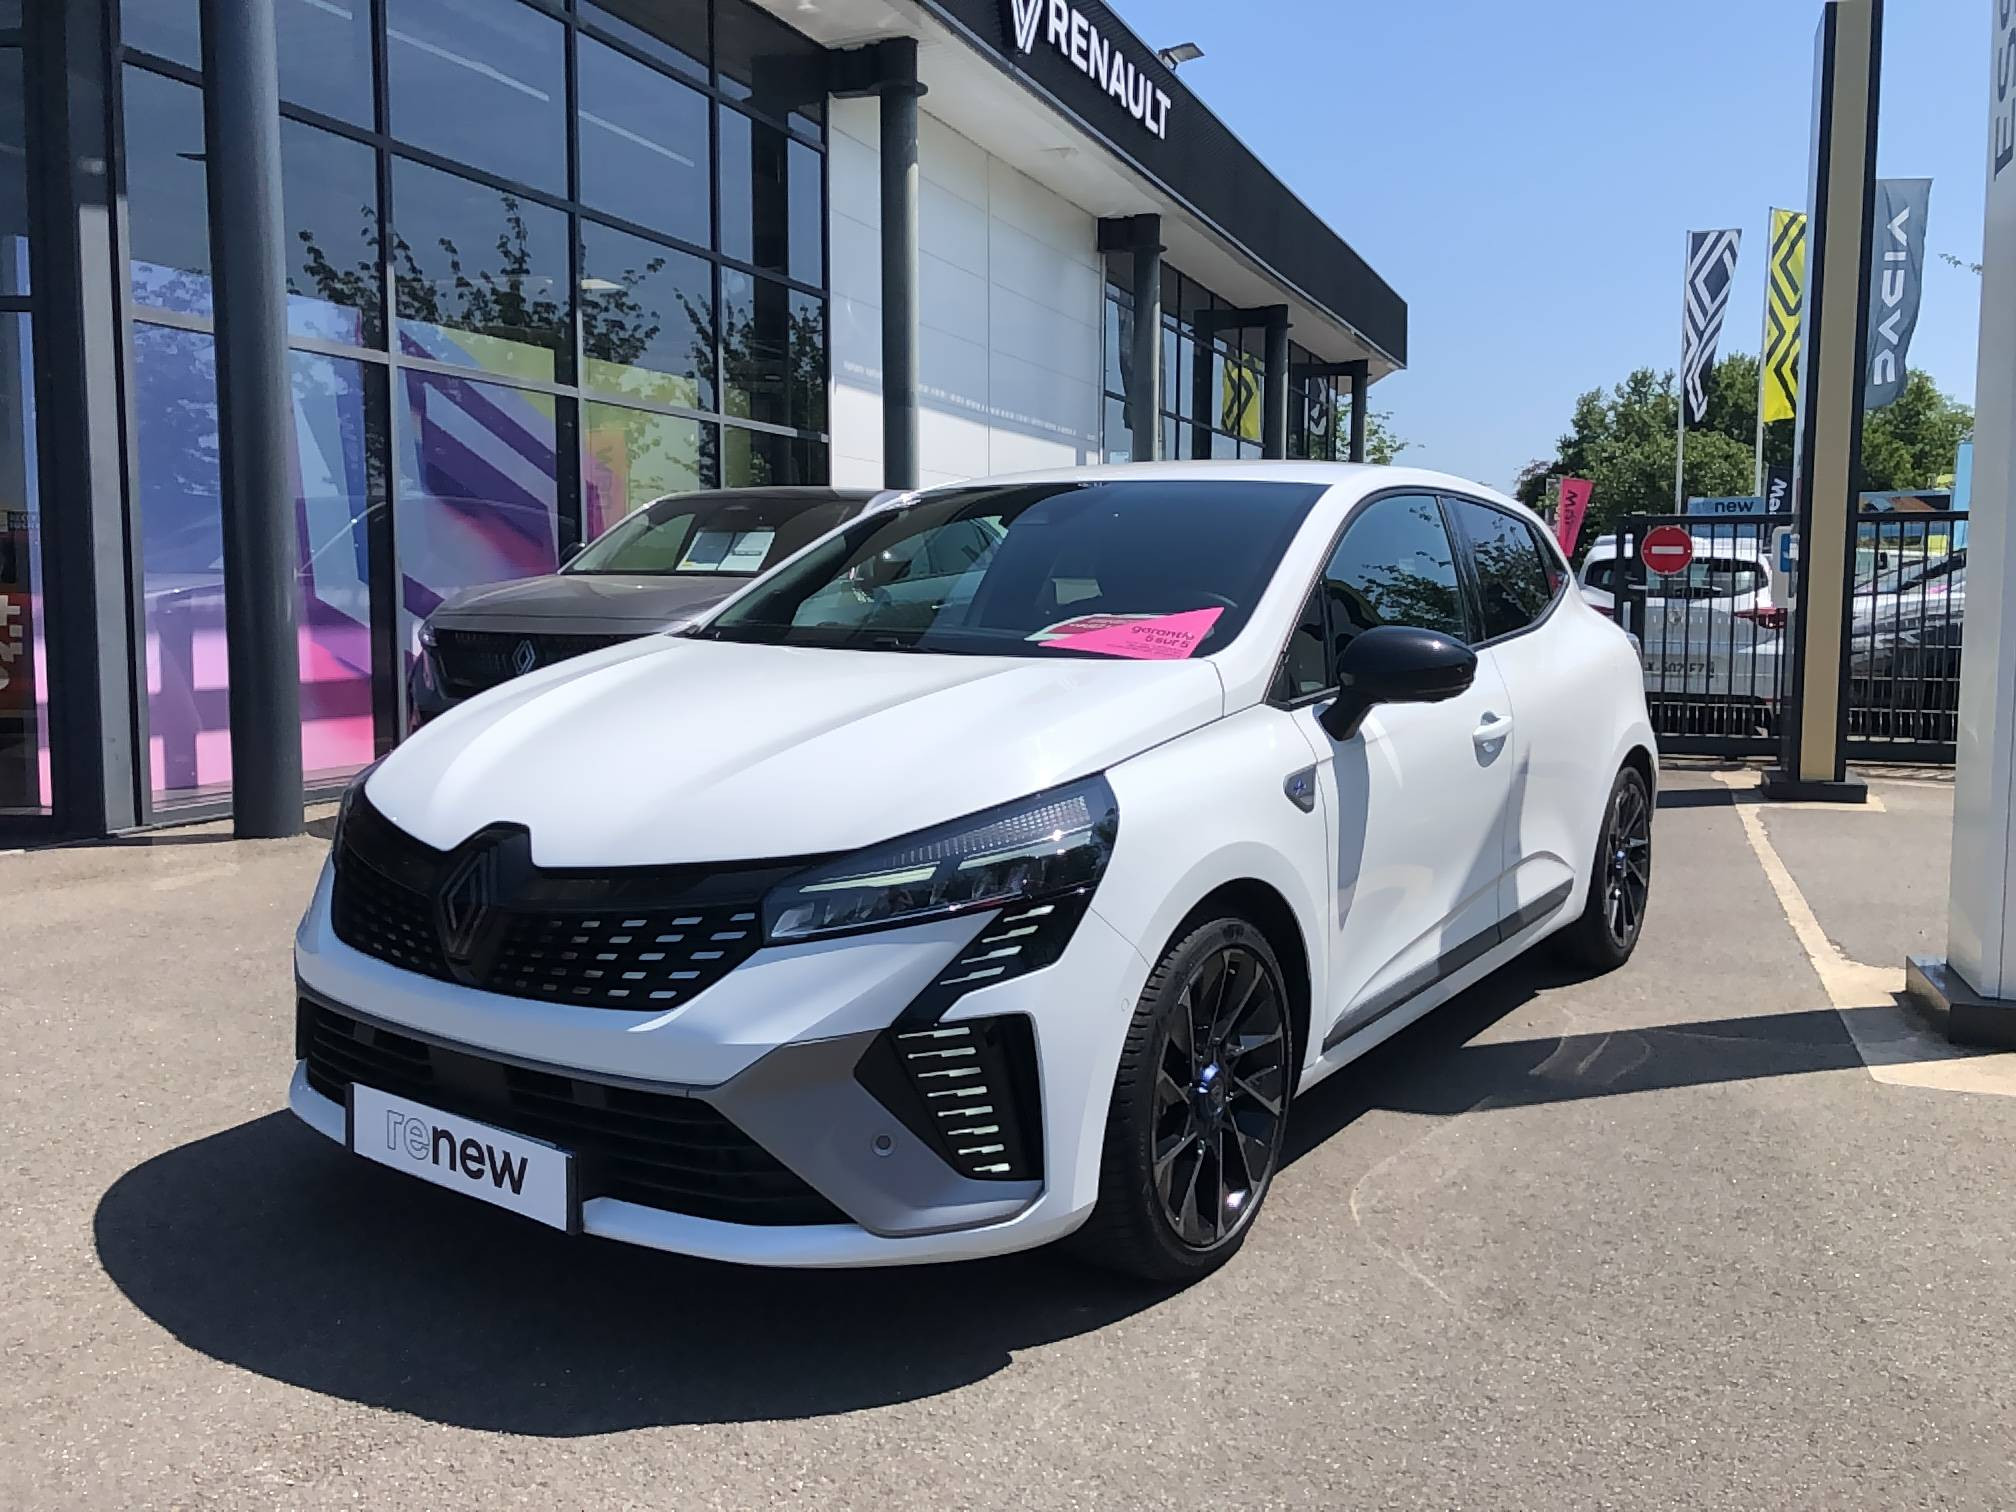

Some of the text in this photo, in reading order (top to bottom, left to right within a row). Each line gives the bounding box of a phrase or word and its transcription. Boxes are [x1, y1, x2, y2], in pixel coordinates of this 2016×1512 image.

[1047, 0, 1171, 140] RENAULT
[1873, 206, 1911, 385] DACIA
[1155, 637, 1180, 646] sur
[1180, 640, 1189, 648] 5
[387, 1110, 528, 1195] renew
